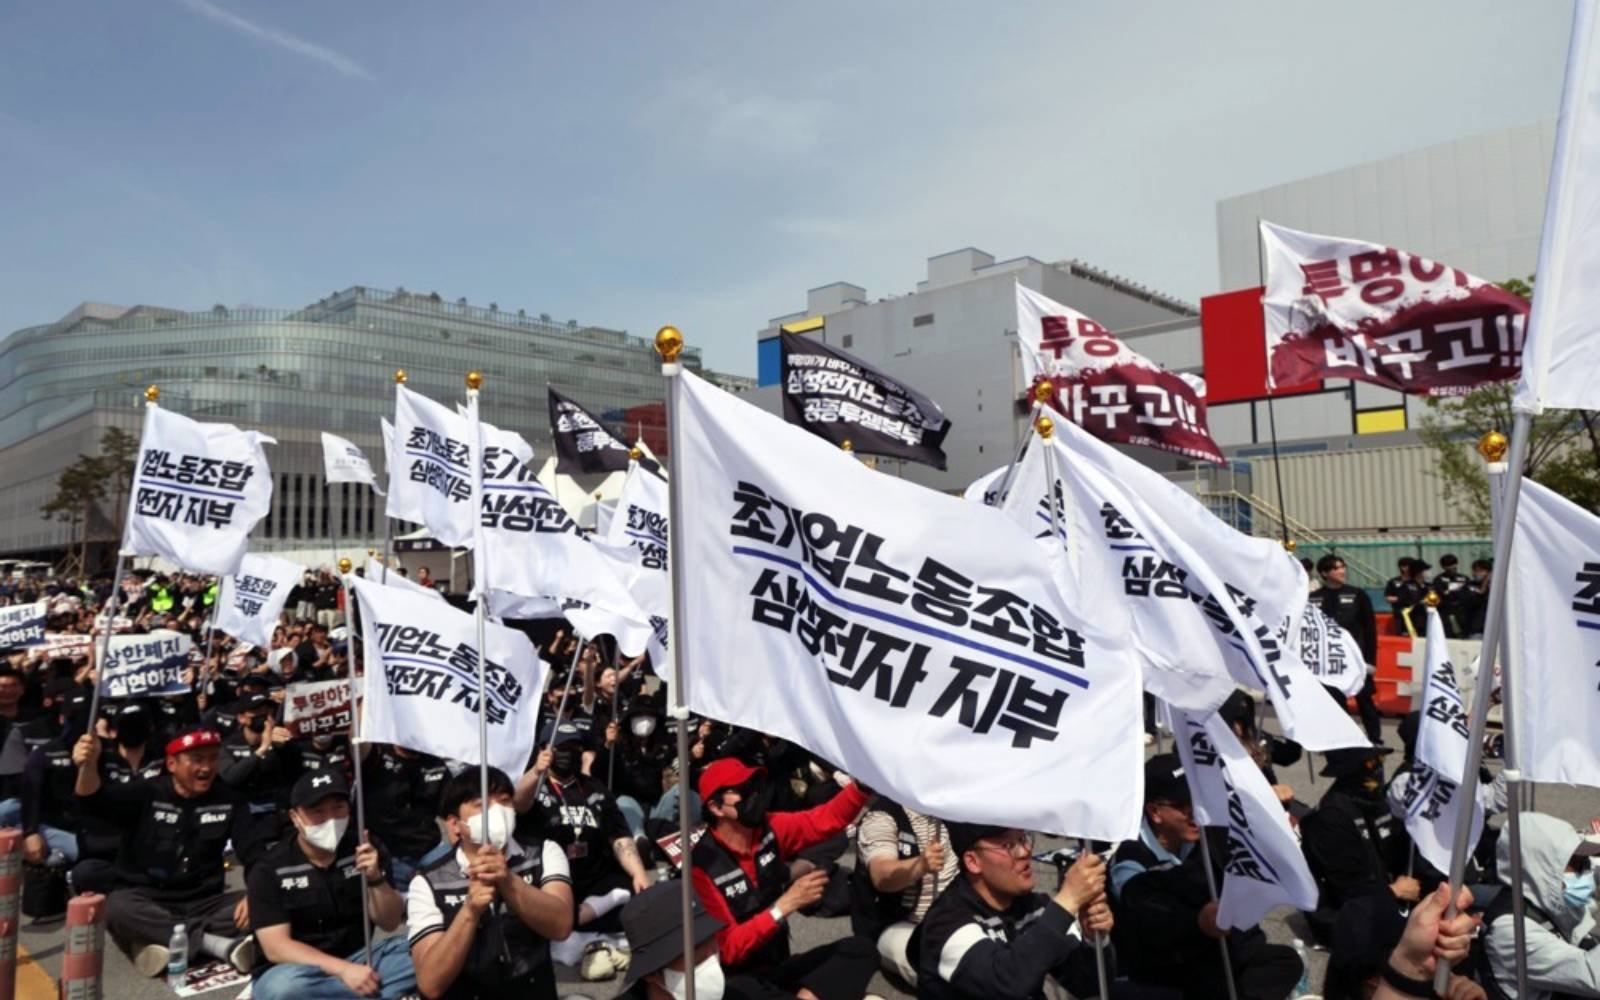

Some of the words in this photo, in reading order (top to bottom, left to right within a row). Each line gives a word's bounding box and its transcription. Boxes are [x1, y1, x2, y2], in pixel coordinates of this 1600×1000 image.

[184, 496, 236, 530] 지부
[481, 493, 591, 542] 삼성전
[730, 480, 1086, 668] 초기업노동조합
[750, 568, 932, 708] 삼성전자
[928, 655, 1070, 749] 지부
